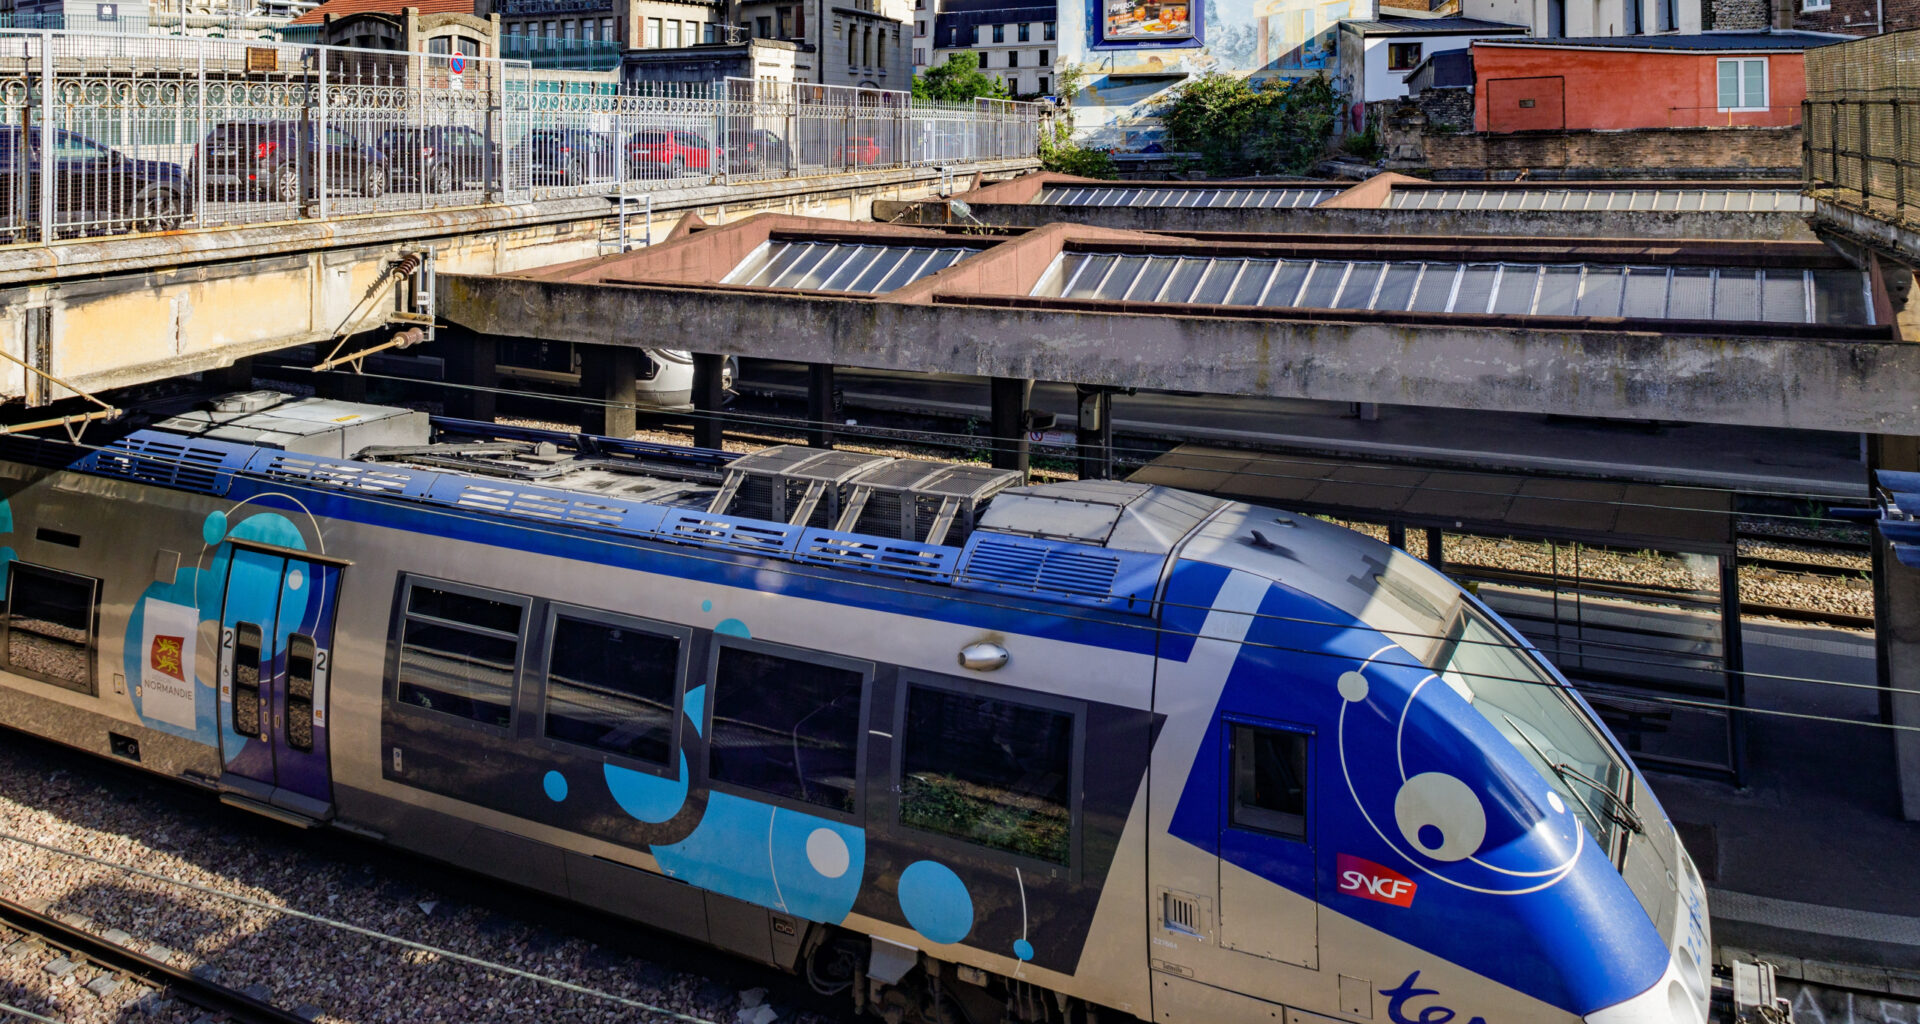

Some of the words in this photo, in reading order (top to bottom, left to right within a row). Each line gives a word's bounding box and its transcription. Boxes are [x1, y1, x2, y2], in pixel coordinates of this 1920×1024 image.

[223, 630, 233, 649] 2
[316, 652, 327, 671] 2
[144, 679, 193, 701] NORMANDIE
[1340, 870, 1412, 899] SNCF
[1378, 970, 1487, 1024] te
